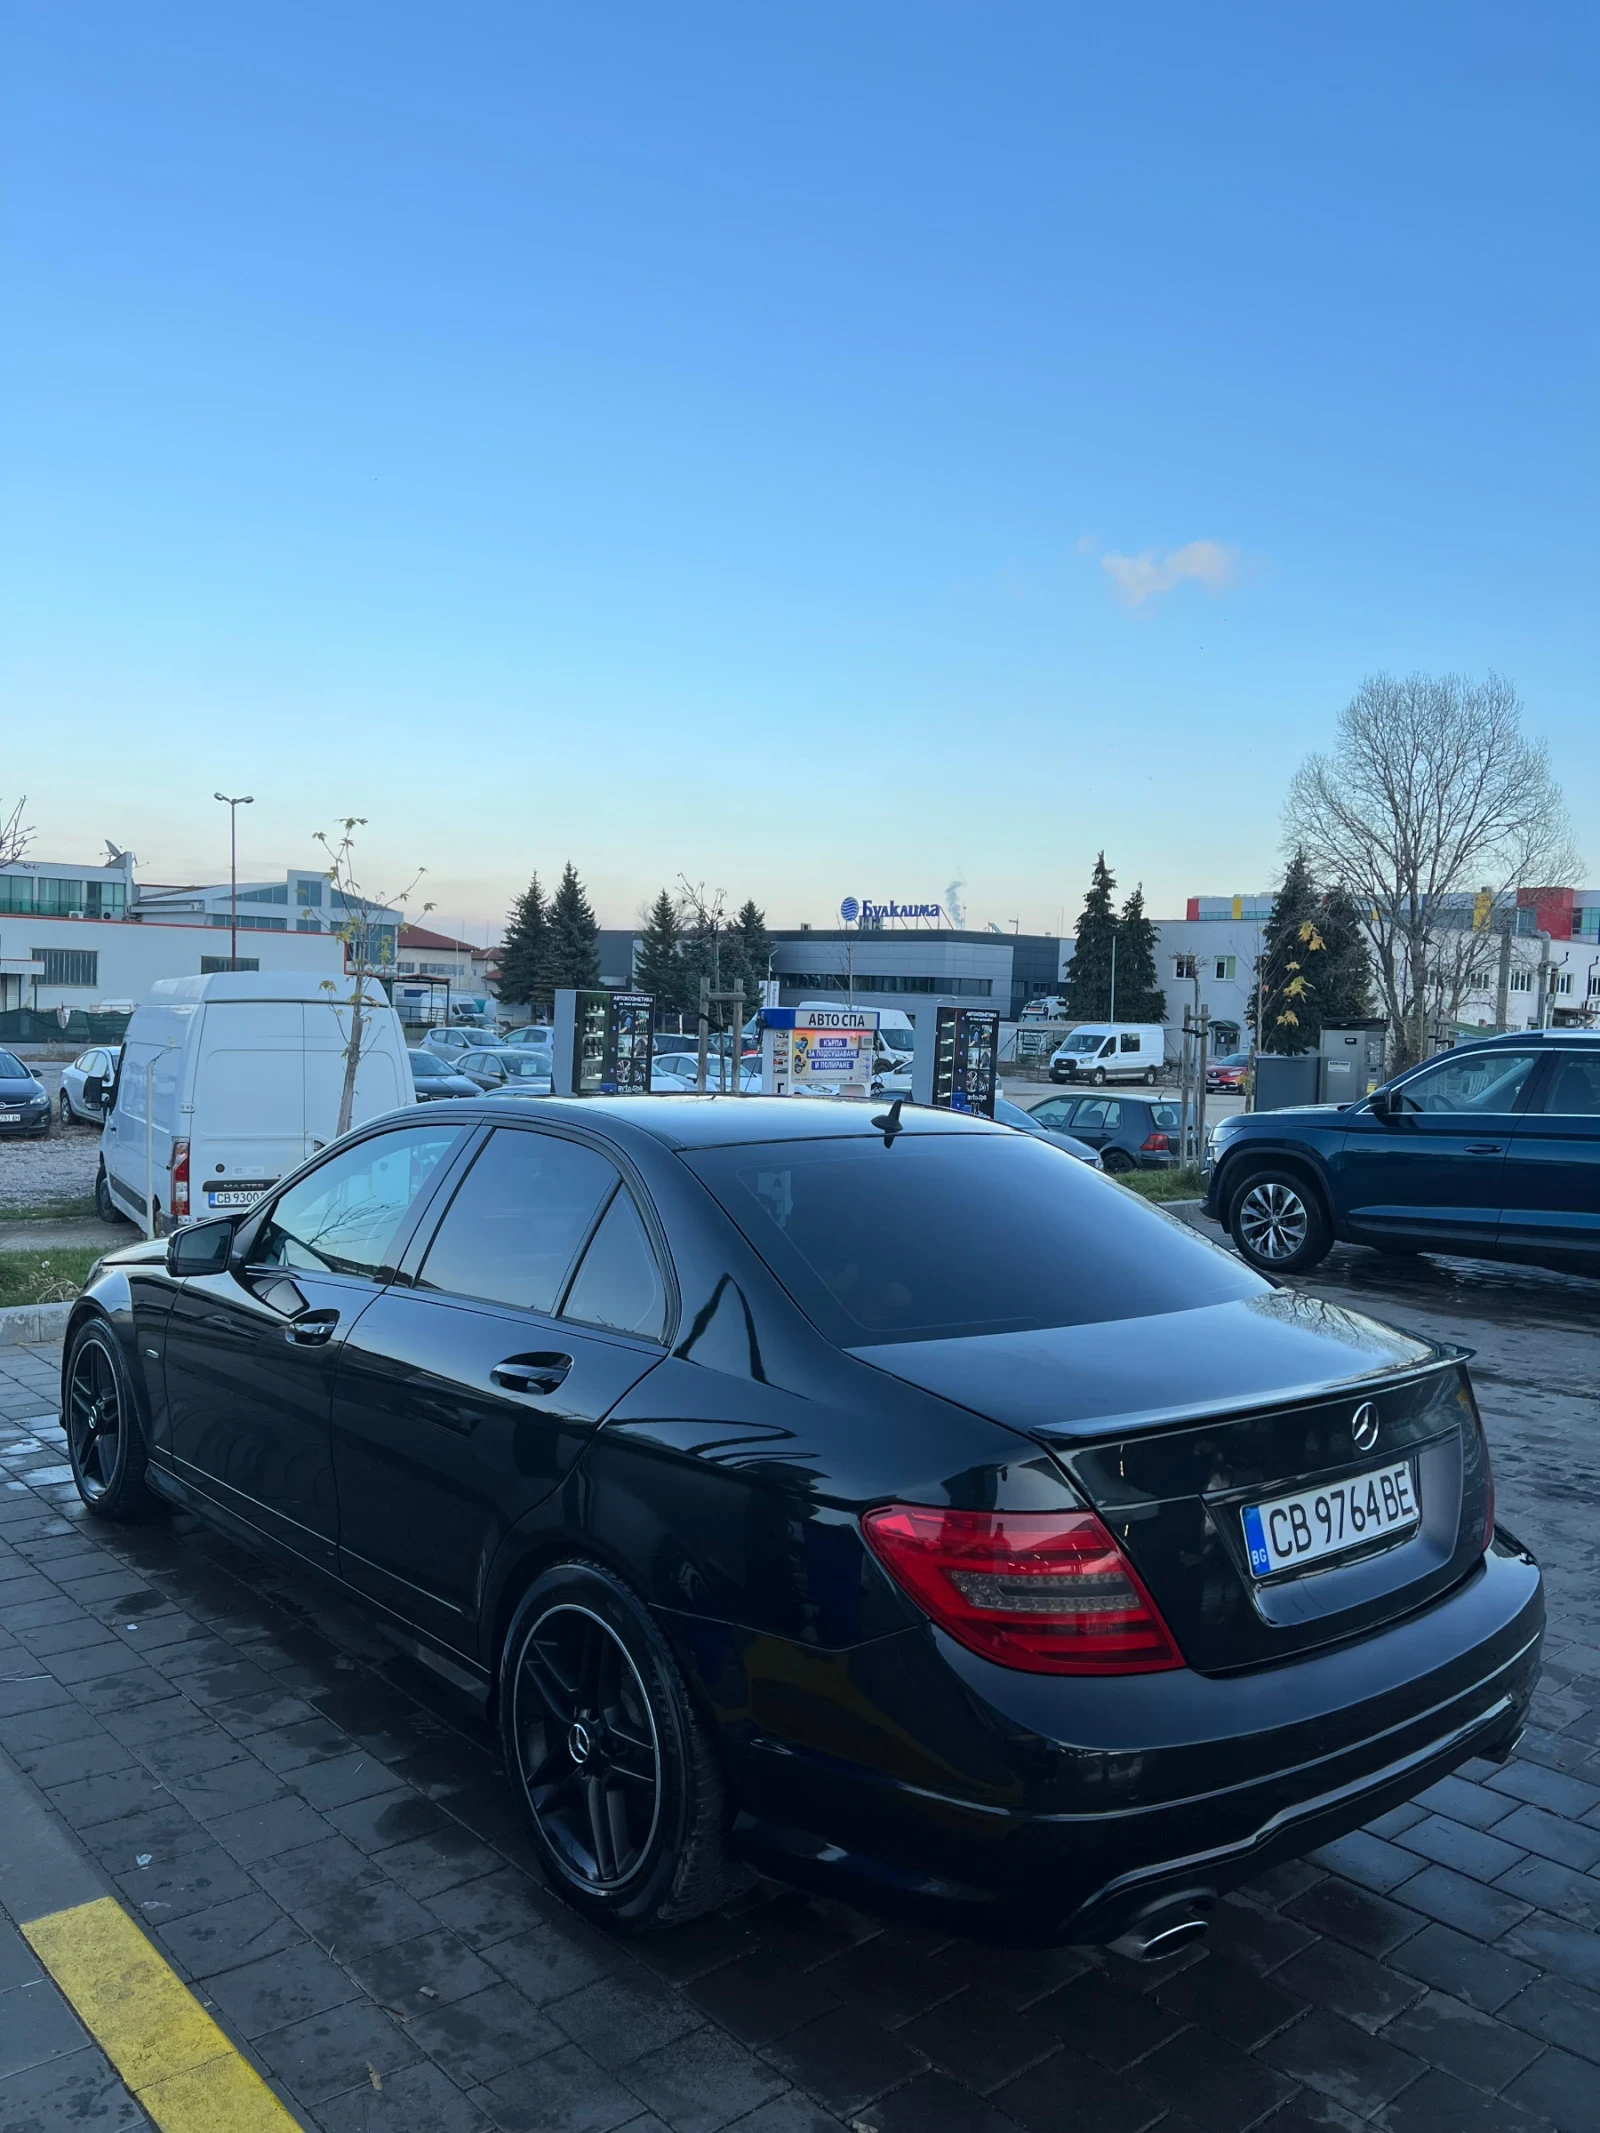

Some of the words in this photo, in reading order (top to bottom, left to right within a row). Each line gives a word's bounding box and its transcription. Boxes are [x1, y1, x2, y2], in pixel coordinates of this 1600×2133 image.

[862, 900, 940, 920] Булклима
[808, 1013, 839, 1026] АВТО
[842, 1014, 865, 1027] СПА
[823, 1039, 843, 1047] КЪРПА
[816, 1050, 858, 1058] ПОДСУШАВАНЕ
[820, 1061, 850, 1069] ПОЛИРАНЕ
[216, 1193, 231, 1203] CB
[233, 1192, 260, 1203] 9300
[1269, 1503, 1312, 1558] CB
[1315, 1480, 1381, 1544] 9764
[1380, 1469, 1413, 1522] BE
[1251, 1548, 1267, 1566] BG
